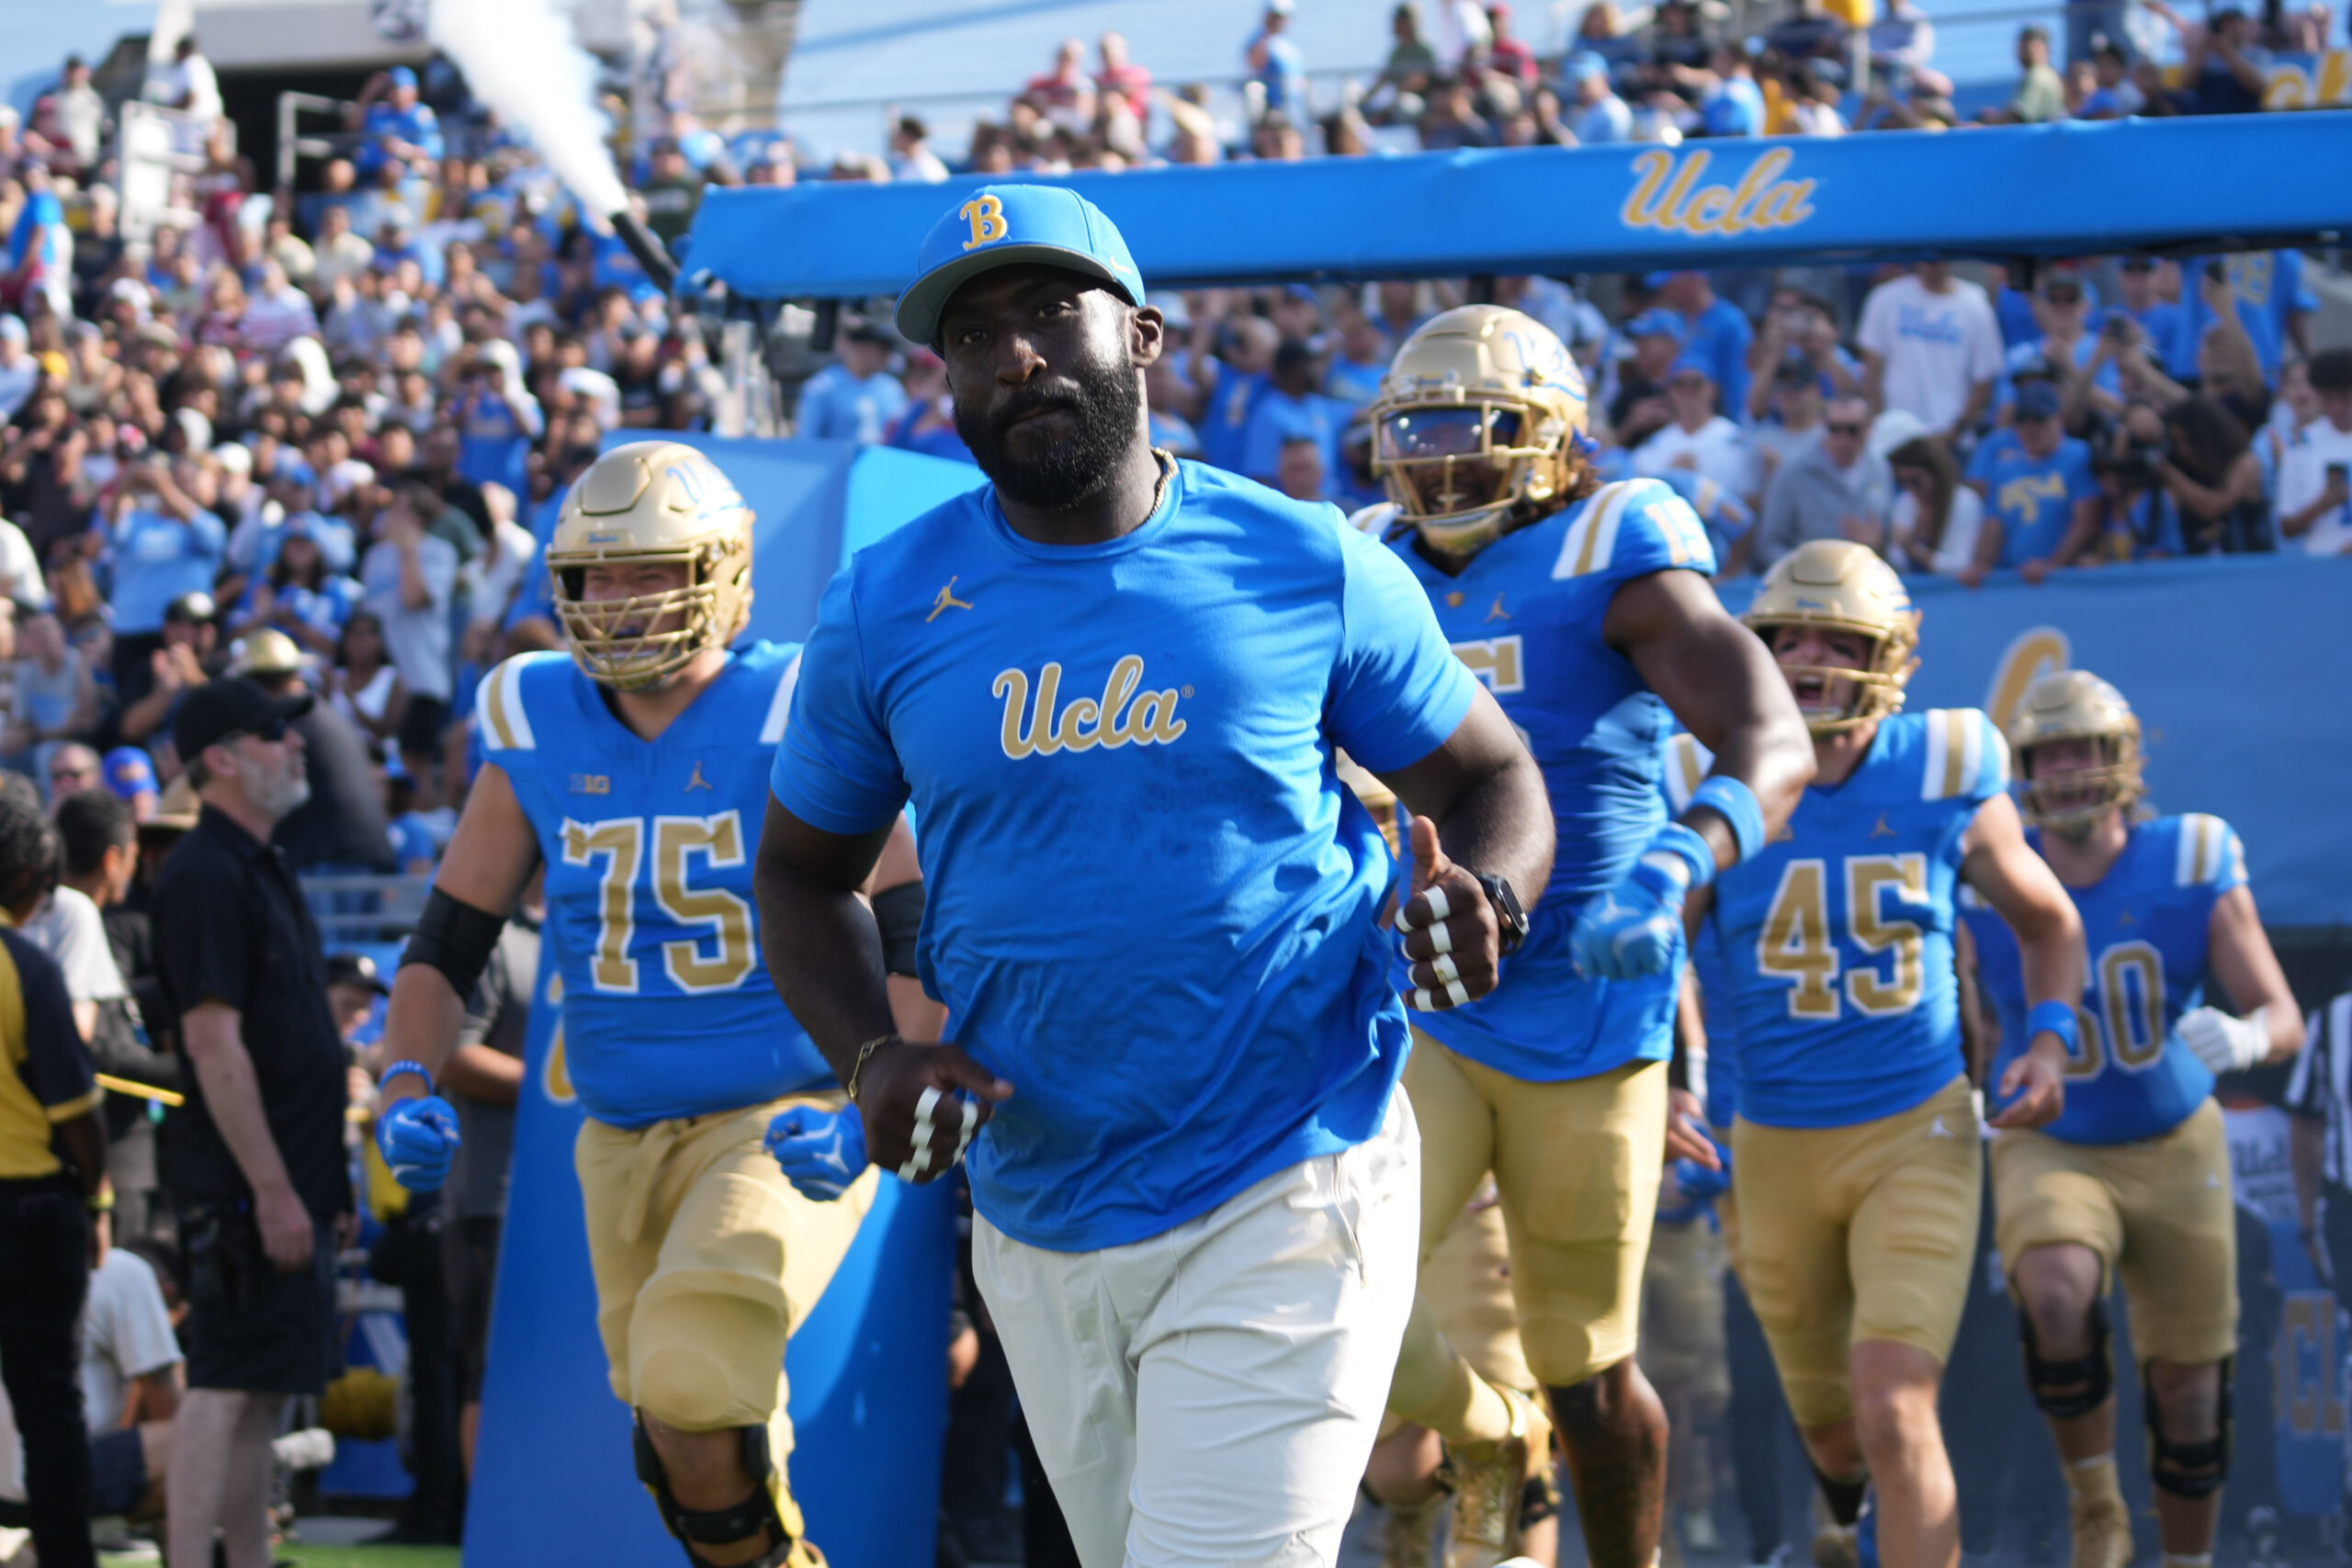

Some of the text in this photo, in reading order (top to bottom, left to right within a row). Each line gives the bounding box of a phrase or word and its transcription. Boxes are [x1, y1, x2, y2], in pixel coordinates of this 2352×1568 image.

[959, 194, 1008, 252] B
[1621, 145, 1817, 237] Ucla
[559, 807, 758, 995] 75
[1756, 851, 1930, 1021] 45
